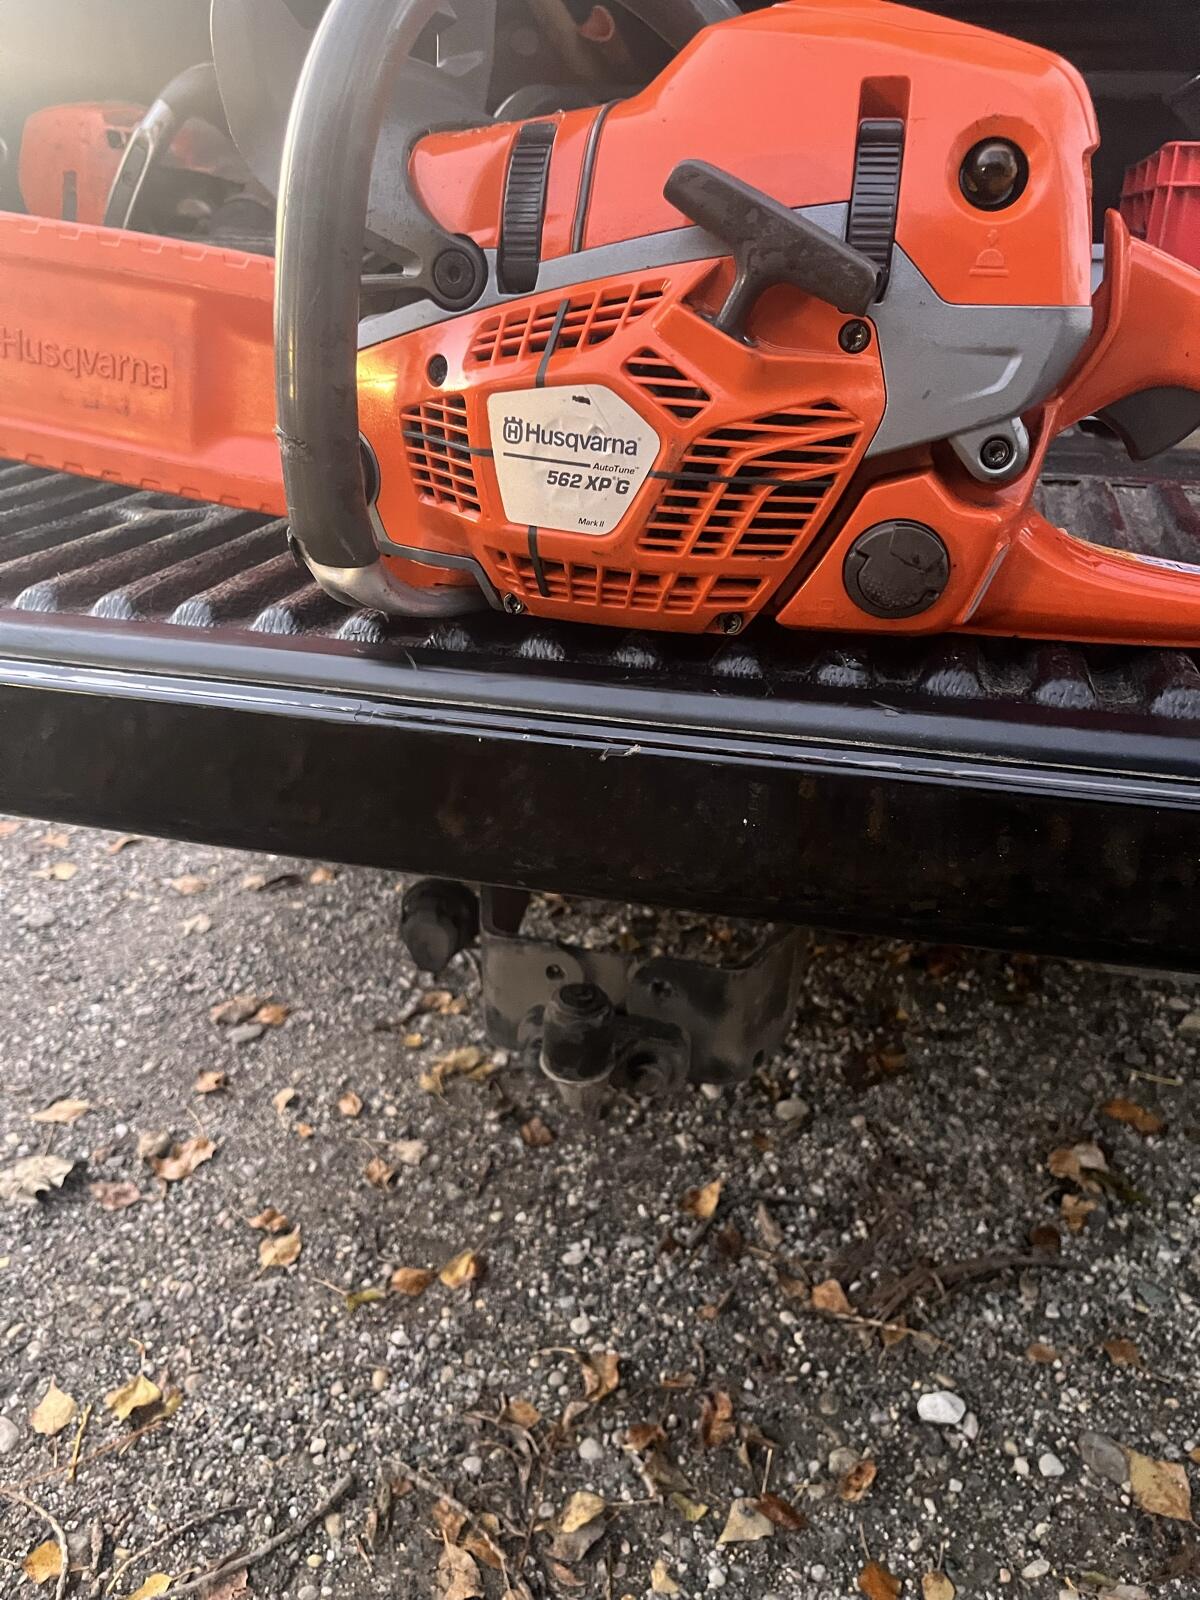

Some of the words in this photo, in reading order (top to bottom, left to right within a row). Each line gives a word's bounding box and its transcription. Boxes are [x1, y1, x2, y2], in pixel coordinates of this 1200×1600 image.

[0, 327, 168, 390] Husqvarna
[525, 422, 638, 456] Husqvarna
[546, 470, 583, 489] 562
[615, 479, 631, 495] G
[578, 517, 598, 528] Mark
